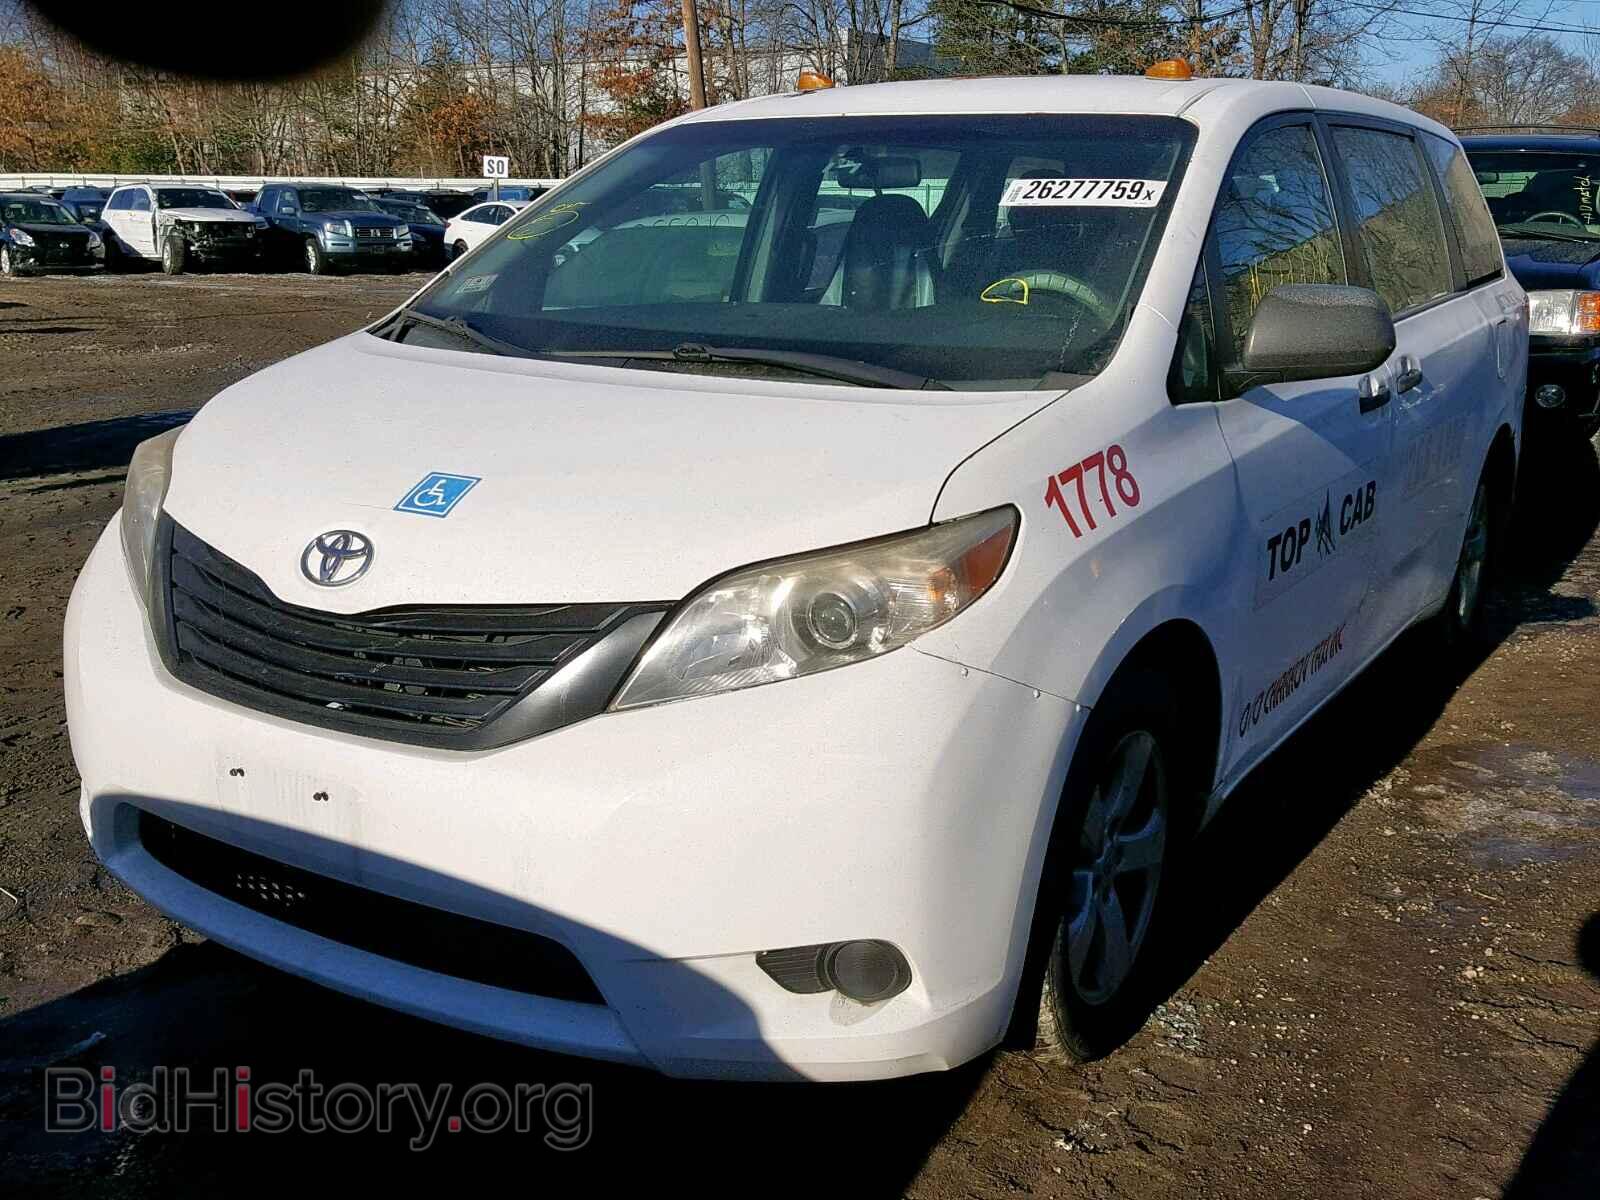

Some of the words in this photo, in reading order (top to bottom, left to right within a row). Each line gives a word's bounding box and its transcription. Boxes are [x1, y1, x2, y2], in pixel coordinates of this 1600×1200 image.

[1044, 444, 1141, 538] 1778
[1267, 518, 1311, 581] TOP
[1340, 480, 1376, 536] CAB
